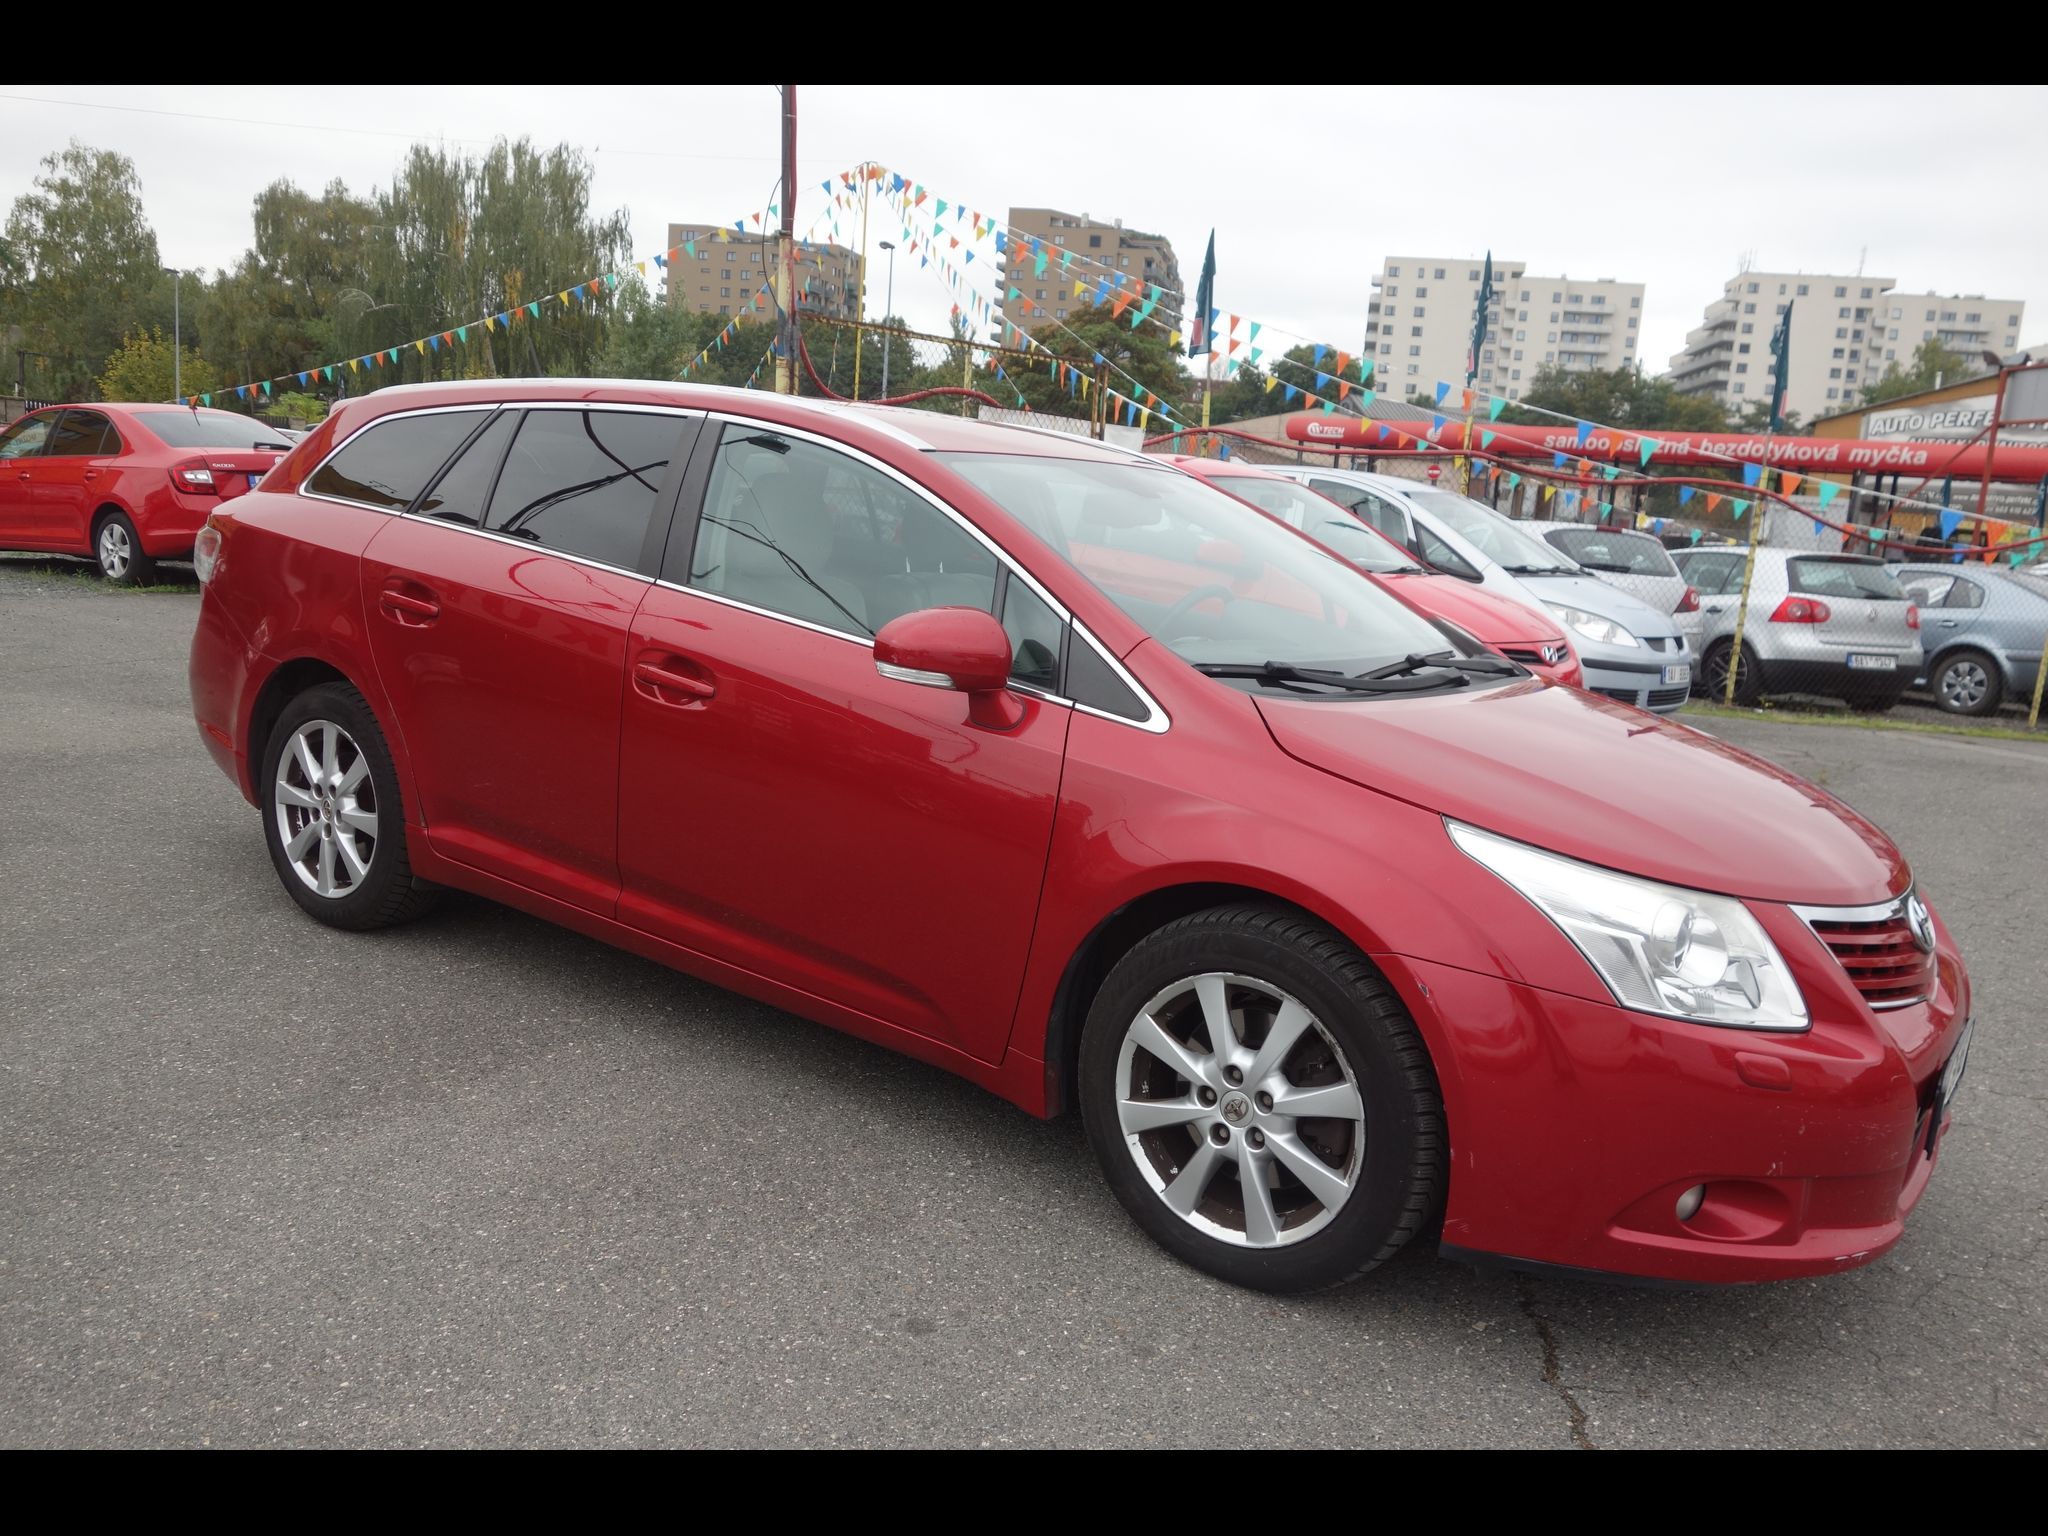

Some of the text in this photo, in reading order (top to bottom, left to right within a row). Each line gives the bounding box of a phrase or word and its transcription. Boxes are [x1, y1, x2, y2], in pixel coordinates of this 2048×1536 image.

[1871, 409, 2012, 436] AUTO PERFE
[1698, 438, 1841, 461] bezdotyková
[1848, 446, 1929, 466] myčka
